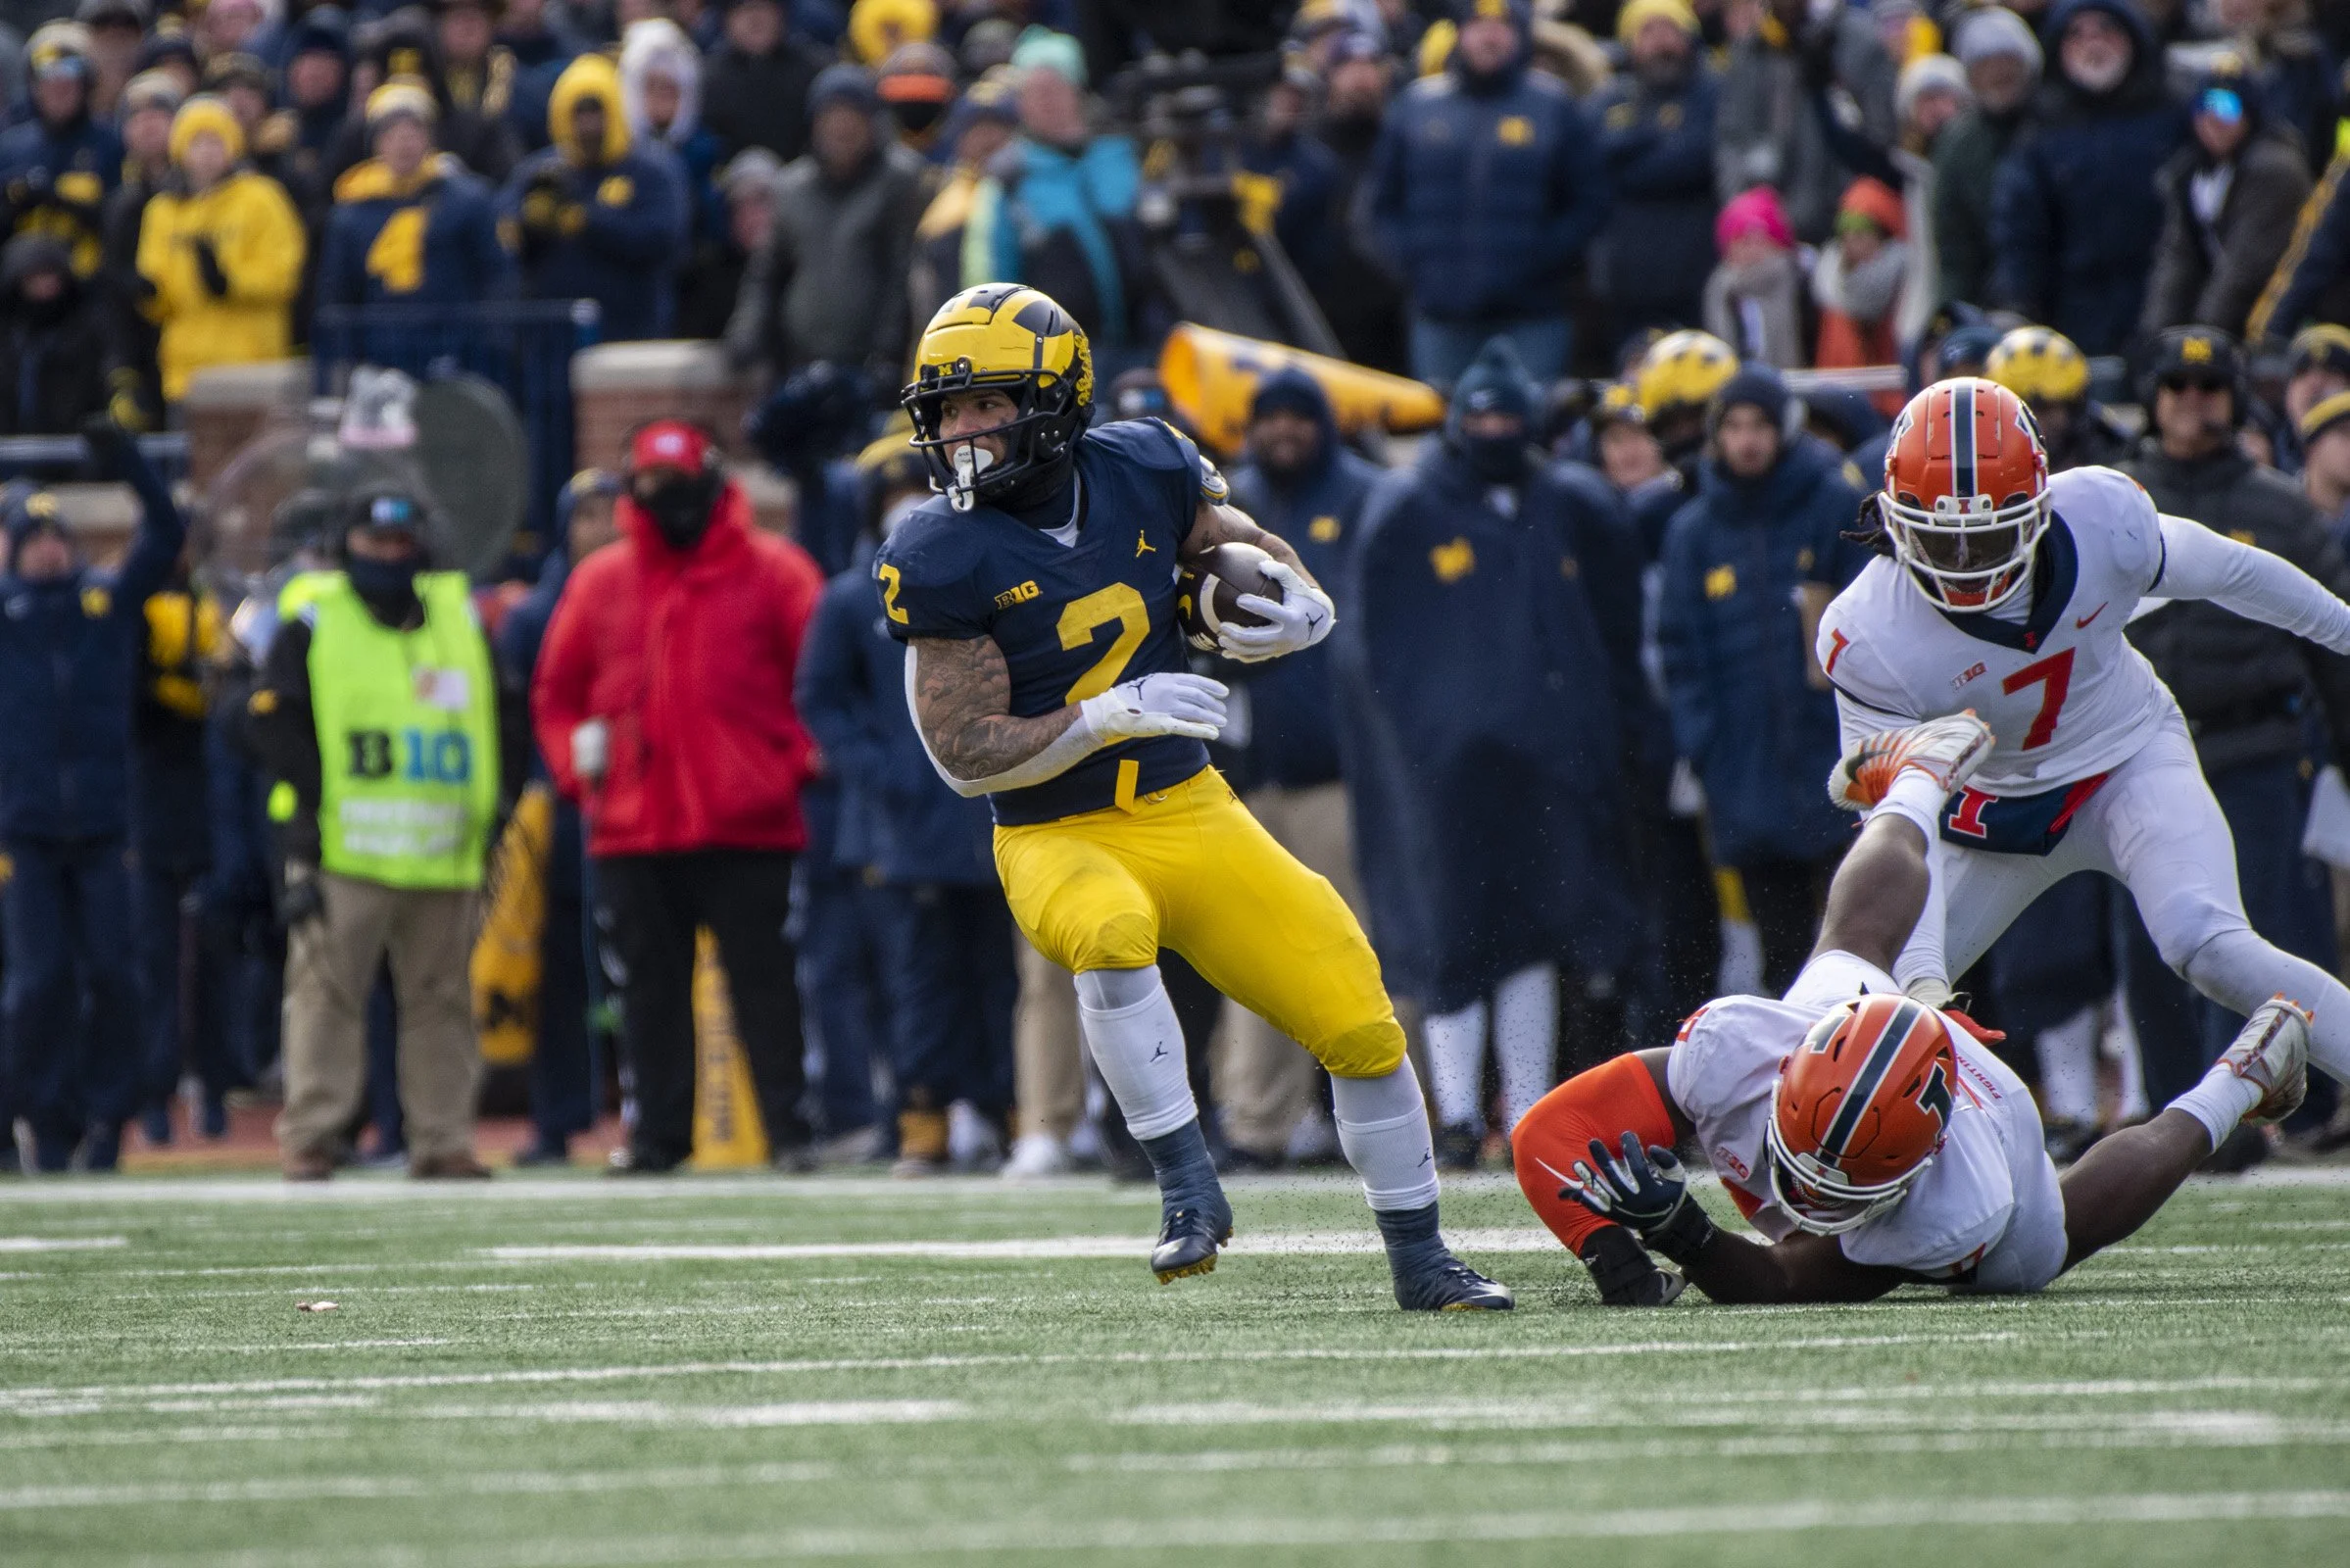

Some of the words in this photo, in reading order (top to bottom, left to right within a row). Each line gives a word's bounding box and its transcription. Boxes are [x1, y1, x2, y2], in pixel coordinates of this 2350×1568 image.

[938, 364, 952, 376] M
[879, 564, 909, 624] 2
[1055, 581, 1151, 737] 2
[1825, 628, 1849, 675] 7
[2002, 647, 2076, 751] 7
